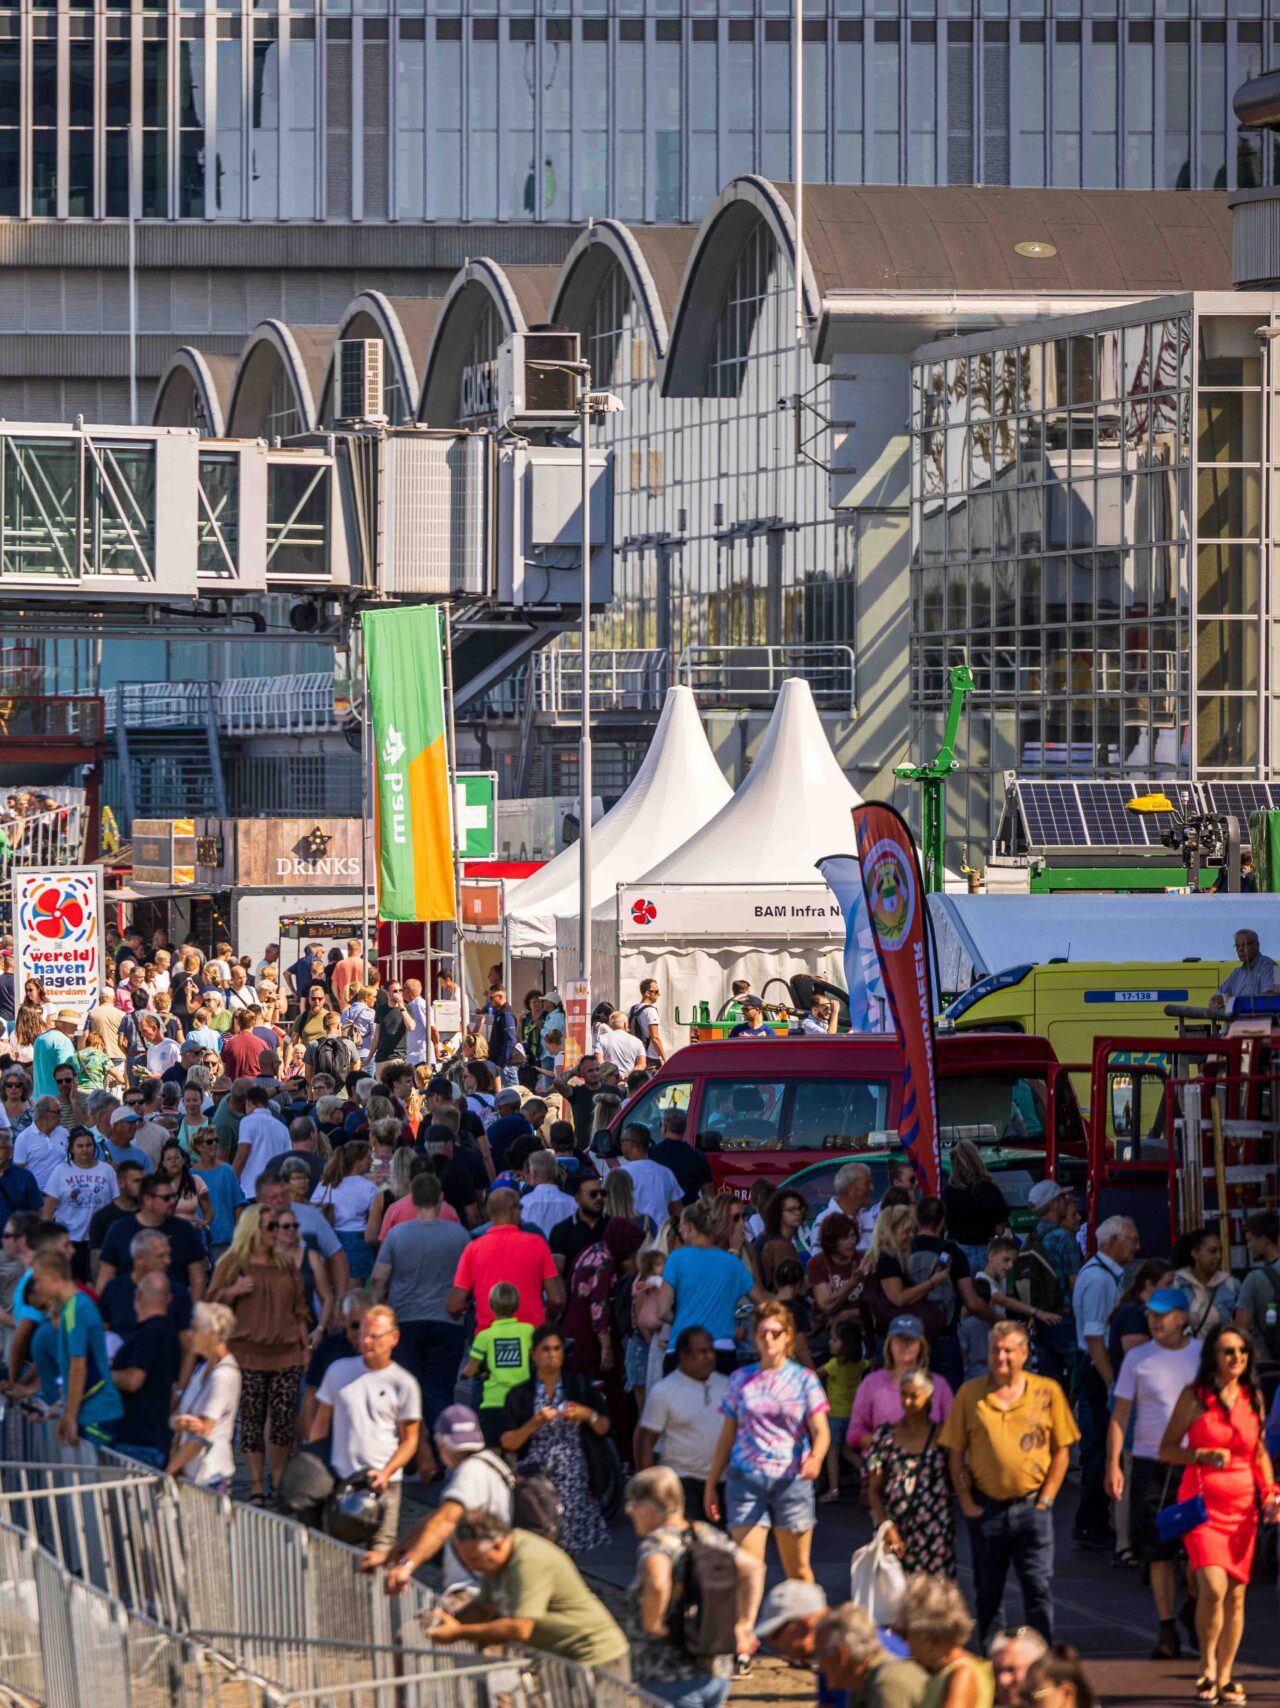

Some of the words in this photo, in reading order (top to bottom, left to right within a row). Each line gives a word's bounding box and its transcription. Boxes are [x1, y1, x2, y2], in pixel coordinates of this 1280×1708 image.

[276, 857, 360, 876] DRINKS
[754, 906, 786, 917] BAM
[791, 905, 826, 917] Infra
[30, 949, 89, 962] wereld
[34, 963, 85, 975] haven
[1121, 992, 1152, 1000] 17-138
